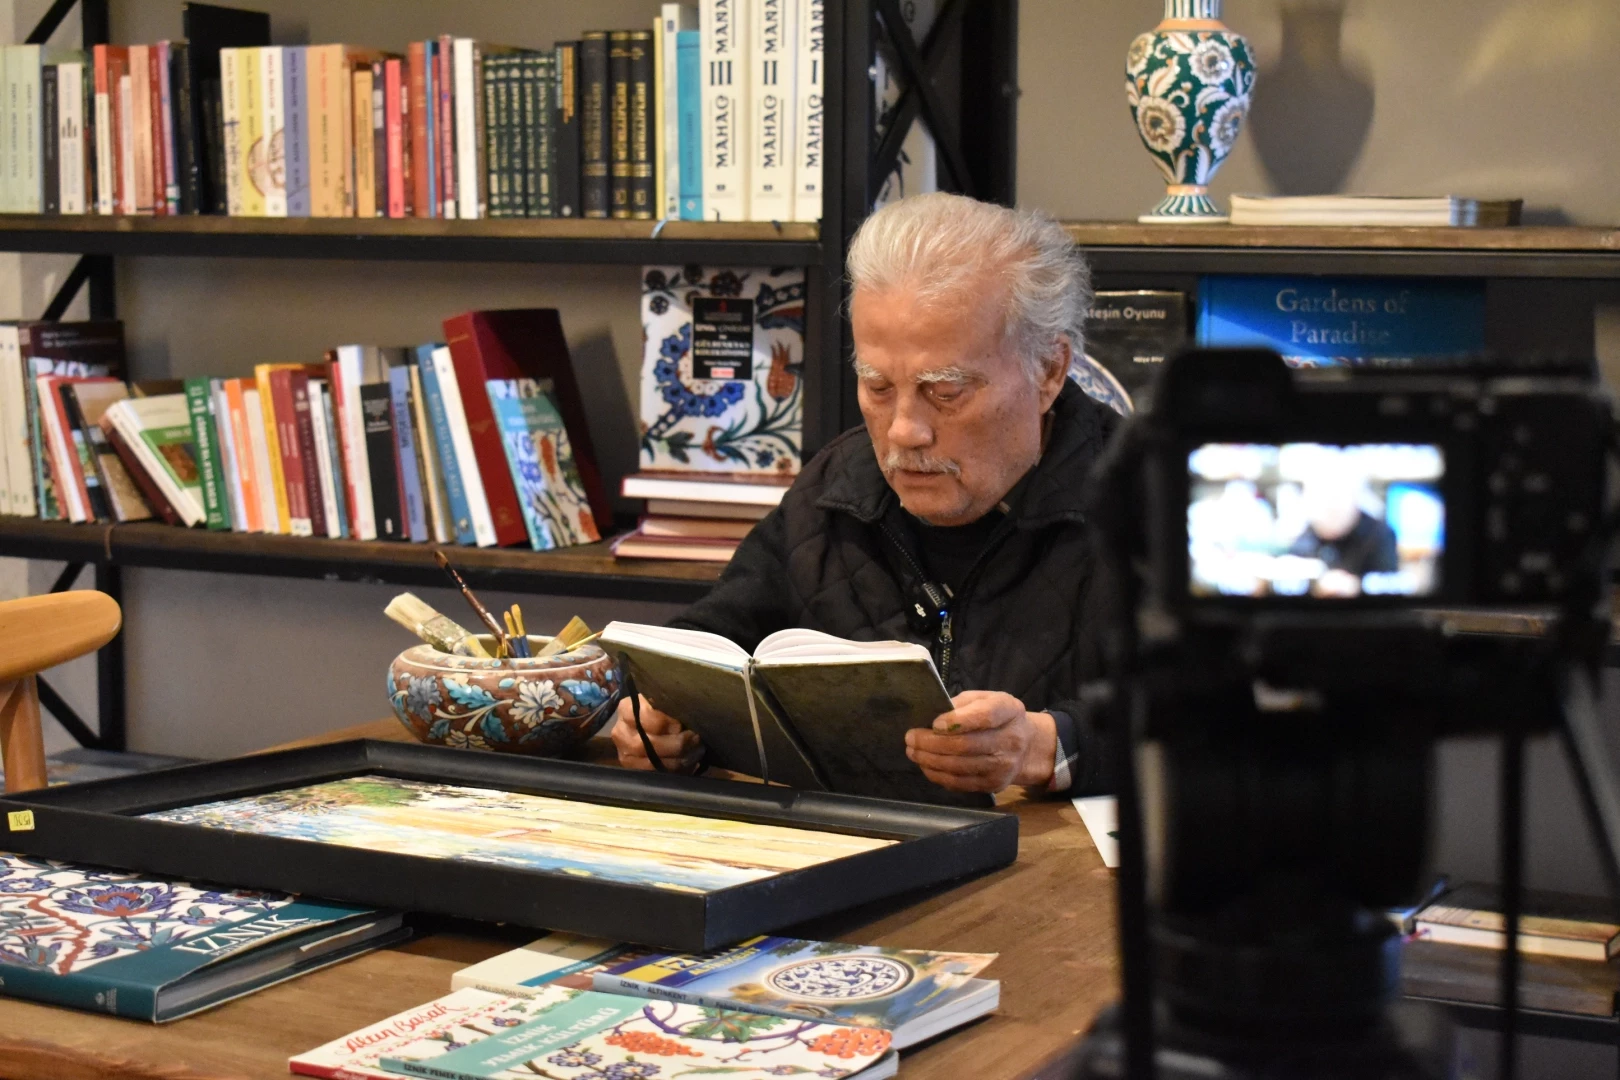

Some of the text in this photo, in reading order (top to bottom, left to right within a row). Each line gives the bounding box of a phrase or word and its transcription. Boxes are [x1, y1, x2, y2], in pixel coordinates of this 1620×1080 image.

[714, 0, 729, 54] MANA
[764, 0, 778, 54] MANA
[709, 60, 733, 87] III
[763, 60, 777, 86] II
[1086, 303, 1166, 322] teşin Oyunu
[1275, 287, 1411, 314] Gardens of
[1290, 319, 1391, 345] Paradise
[393, 1003, 468, 1034] Başak
